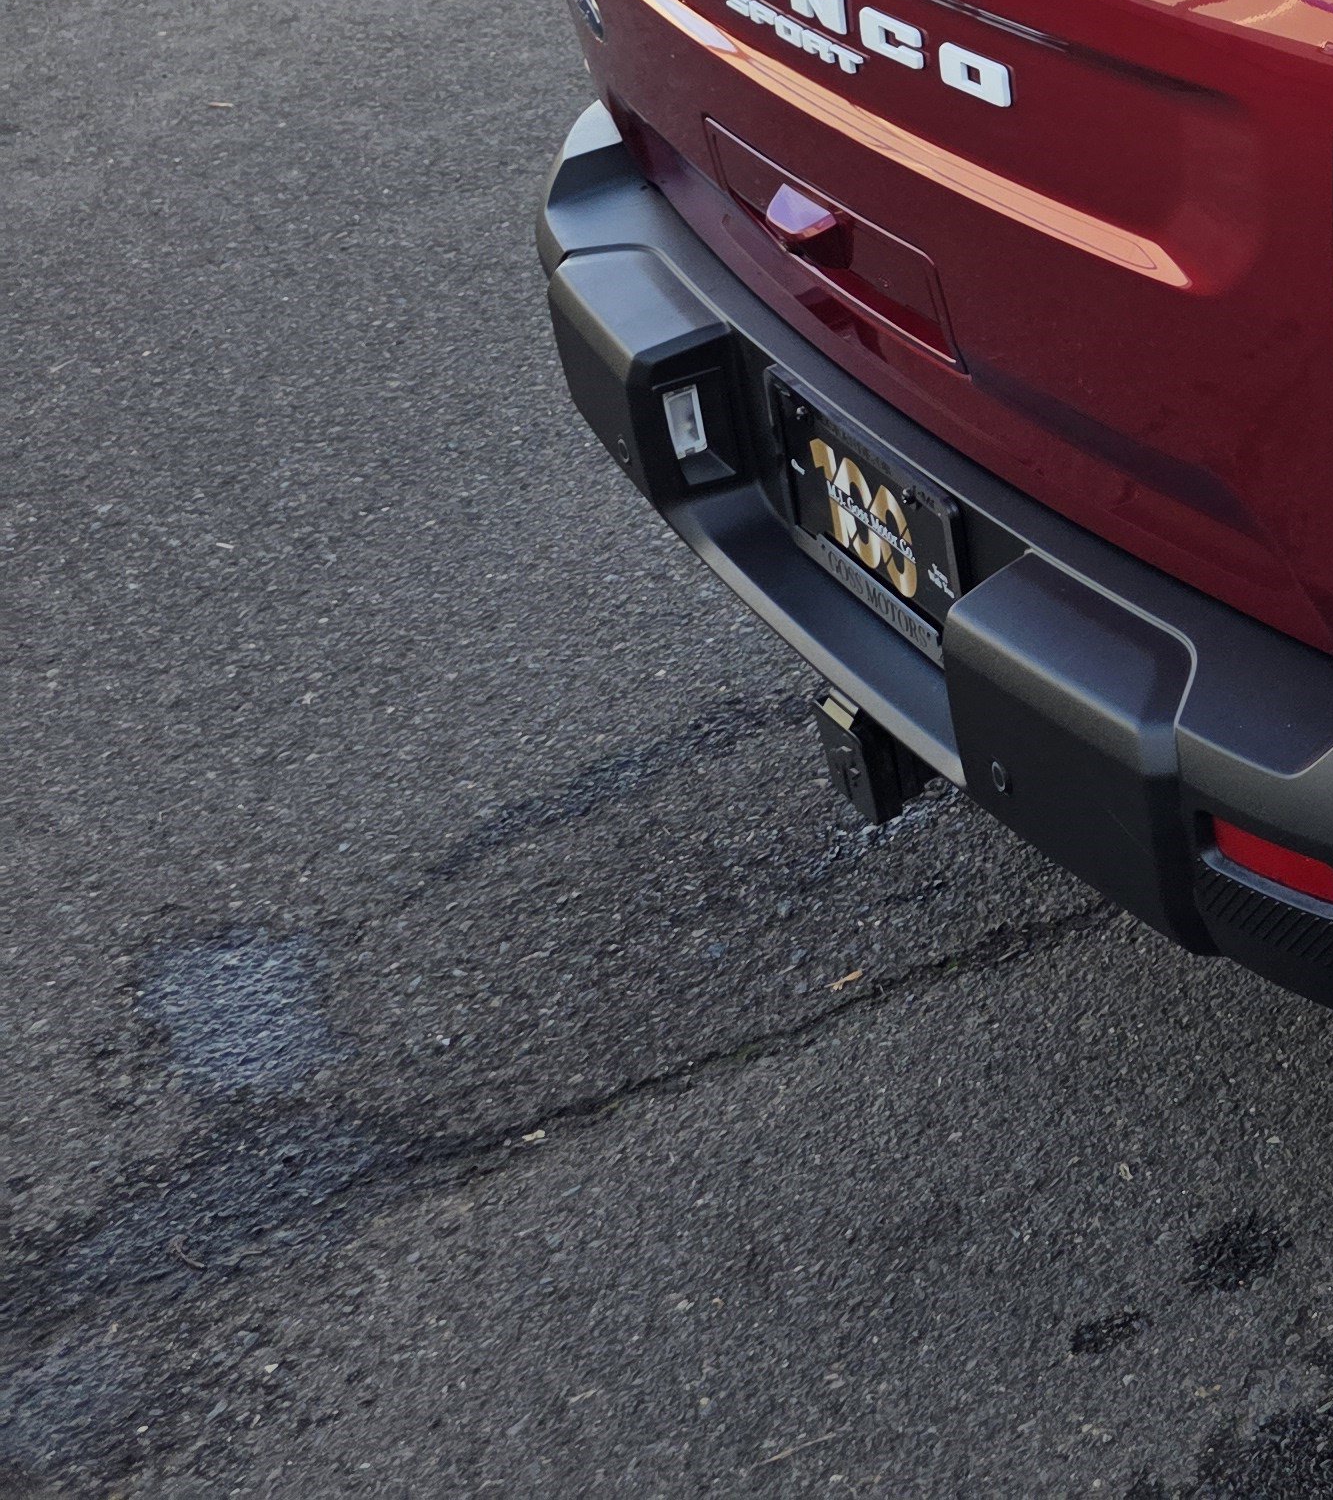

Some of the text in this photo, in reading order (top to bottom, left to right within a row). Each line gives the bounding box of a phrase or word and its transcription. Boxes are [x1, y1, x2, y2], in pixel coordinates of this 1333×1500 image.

[809, 438, 918, 599] 100
[827, 550, 864, 595] GOSS
[865, 580, 928, 649] MOTORS
